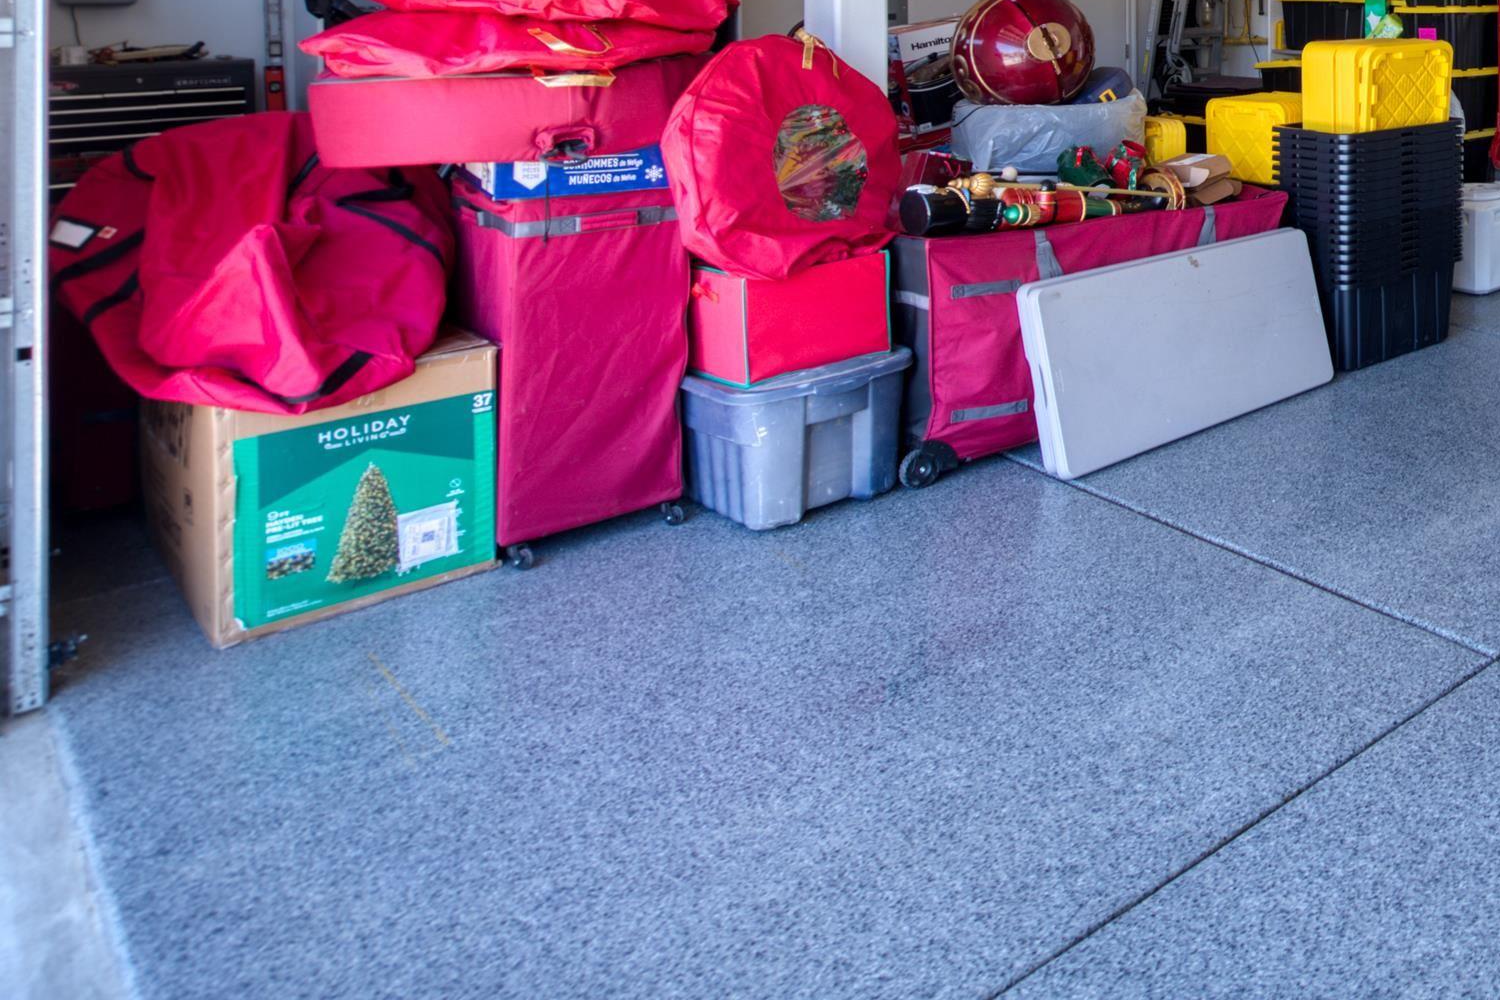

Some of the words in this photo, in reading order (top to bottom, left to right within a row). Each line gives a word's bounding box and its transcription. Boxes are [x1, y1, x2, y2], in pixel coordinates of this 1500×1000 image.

[569, 173, 612, 185] MUÑECOS
[473, 392, 493, 407] 37
[318, 415, 410, 443] HOLIDAY
[345, 432, 387, 446] LIVING
